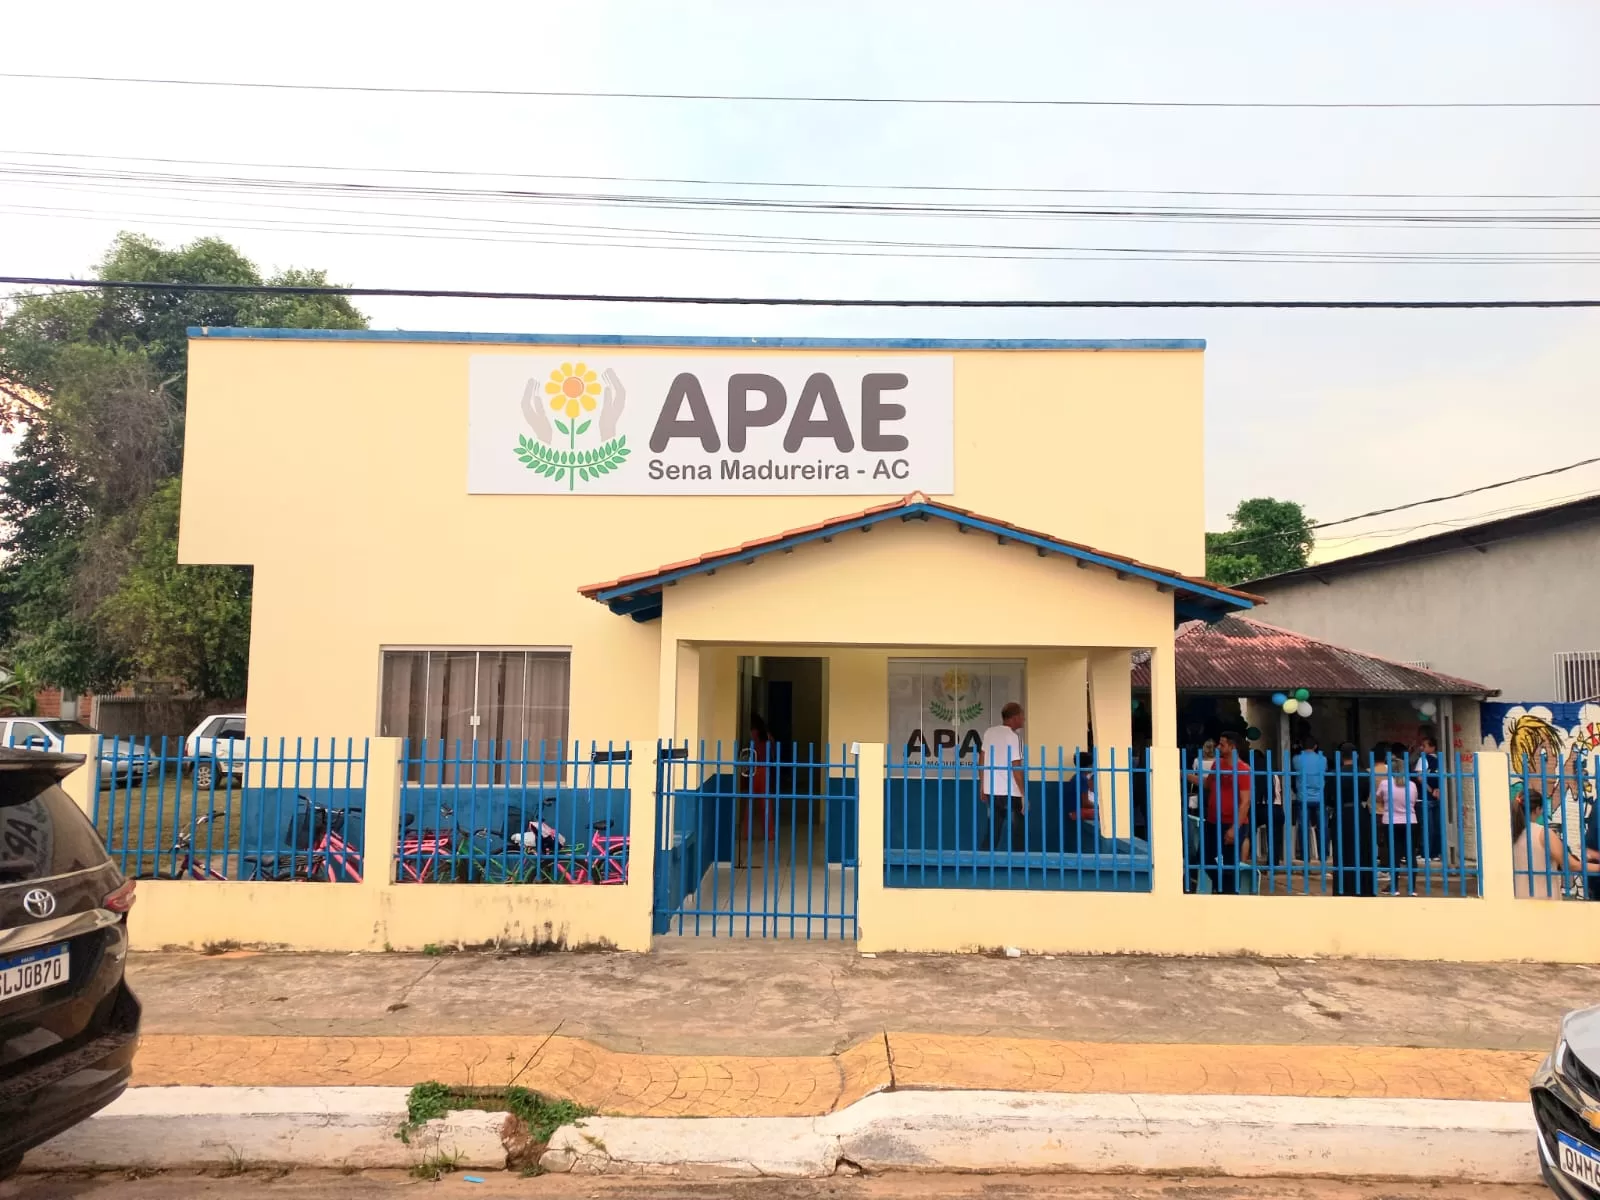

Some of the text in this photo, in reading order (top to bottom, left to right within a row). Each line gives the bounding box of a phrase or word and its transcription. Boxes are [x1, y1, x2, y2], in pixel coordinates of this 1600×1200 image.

[649, 372, 909, 453] APAE
[648, 459, 712, 480] Sena
[720, 459, 850, 480] Madureira
[873, 459, 910, 480] AC
[903, 729, 982, 758] APA
